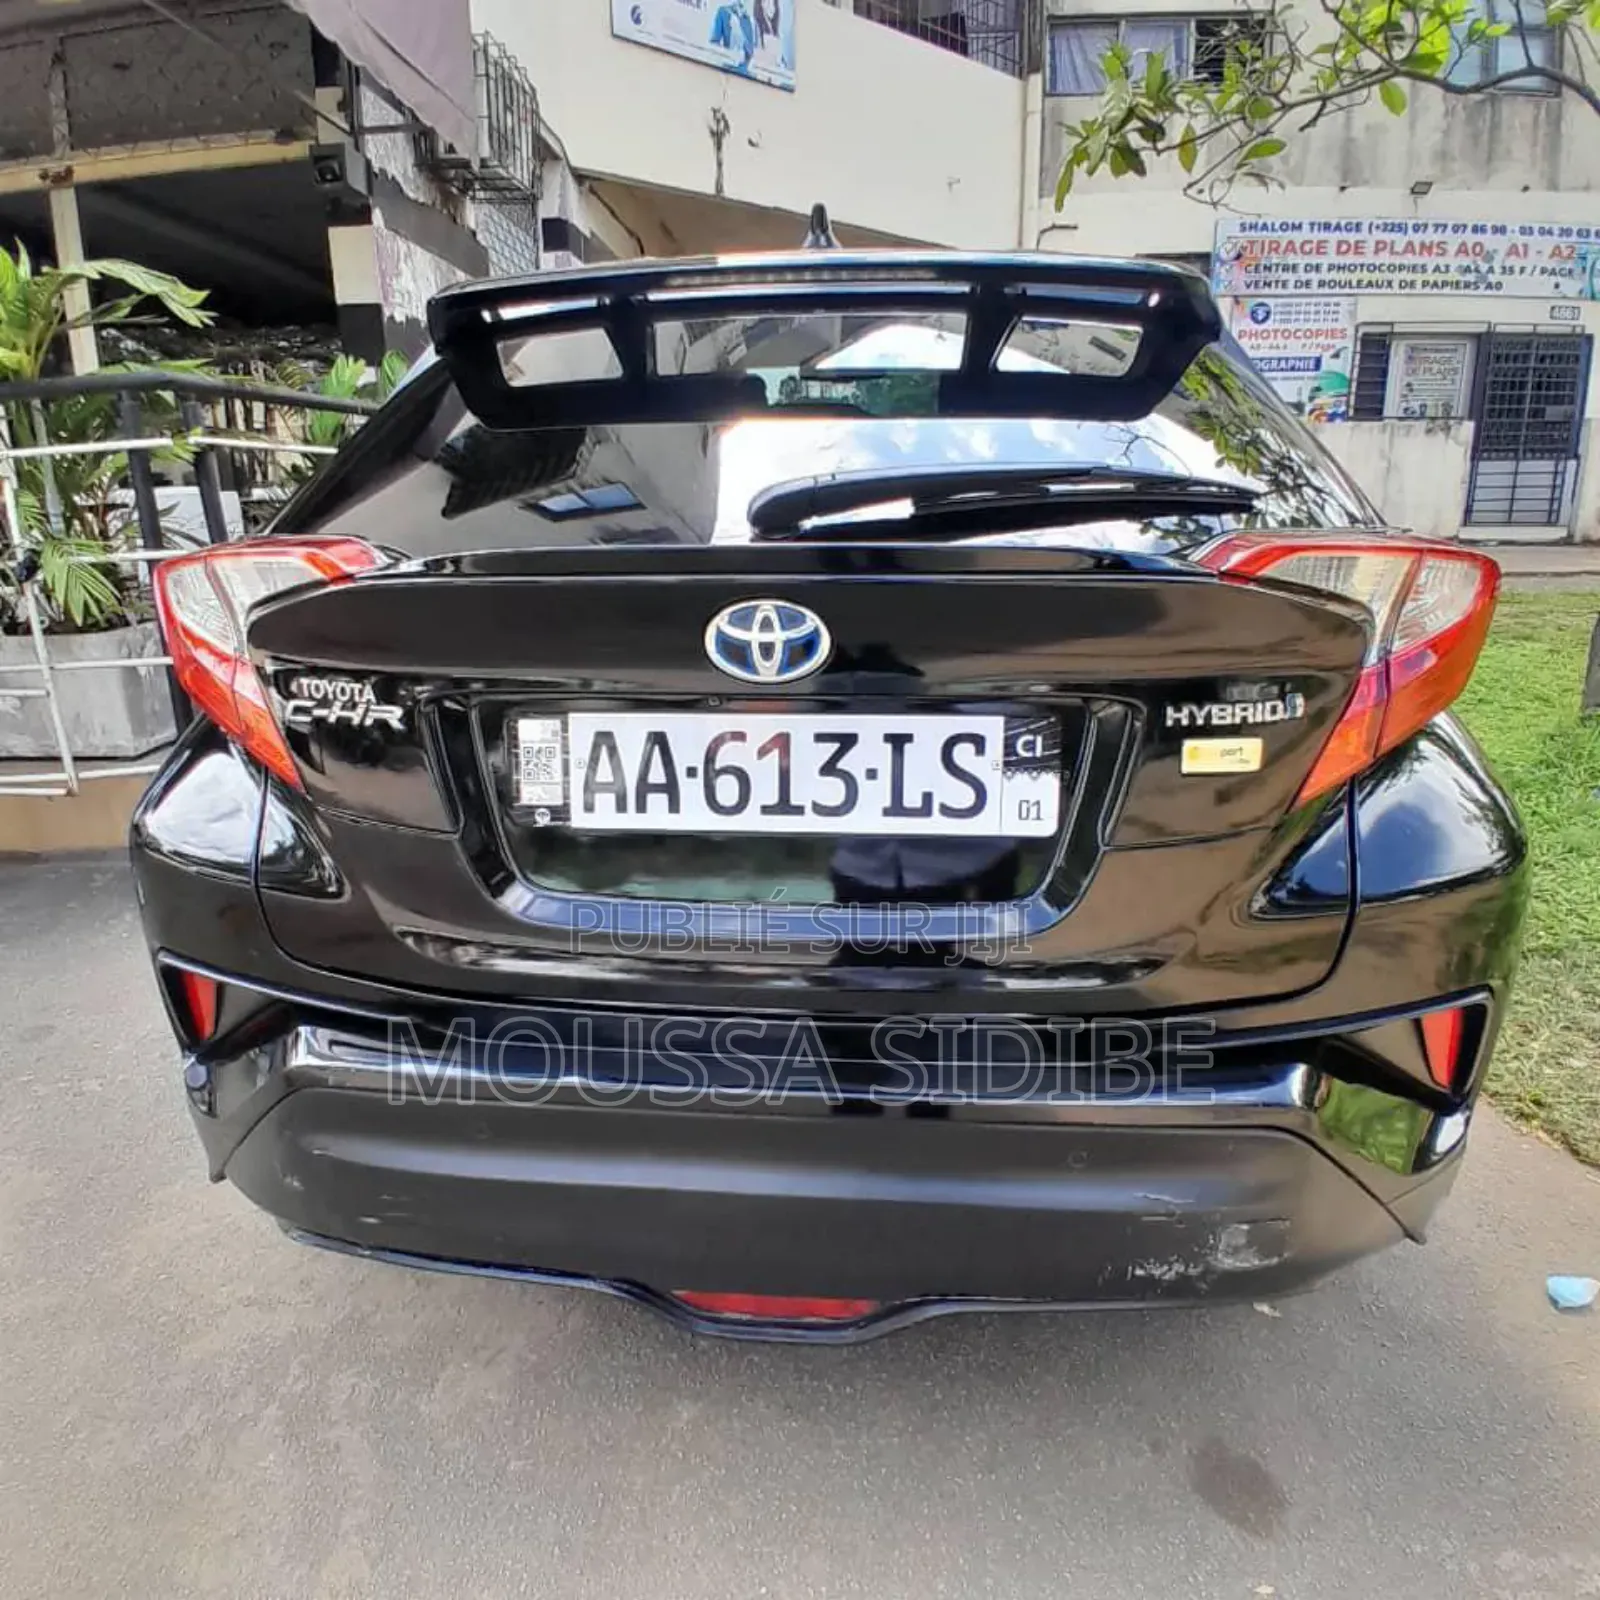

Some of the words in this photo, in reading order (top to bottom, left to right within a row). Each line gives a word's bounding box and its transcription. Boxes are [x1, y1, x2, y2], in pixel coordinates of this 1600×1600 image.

[1239, 221, 1303, 233] SHALOM
[1308, 221, 1363, 233] TIRAGE
[1367, 222, 1409, 236] (+225)
[1412, 223, 1429, 233] 07
[1245, 239, 1329, 256] TIRAGE
[1336, 240, 1367, 256] DE
[1374, 240, 1448, 257] PLANS
[1504, 242, 1529, 259] A1
[1548, 244, 1577, 260] A2
[1244, 263, 1299, 274] CENTRE
[1304, 263, 1324, 274] DE
[1327, 263, 1428, 275] PHOTOCOPIES
[1244, 279, 1291, 290] VENTE
[1294, 280, 1313, 290] DE
[1317, 279, 1394, 290] ROULEAUX
[1399, 280, 1417, 290] DE
[1421, 280, 1481, 291] PAPIERS
[1238, 327, 1348, 341] PHOTOCOPIES
[299, 677, 377, 703] TOYOTA
[284, 699, 407, 731] C-HR
[1165, 700, 1284, 728] HYBRID
[1015, 735, 1043, 758] CI
[1017, 799, 1045, 821] 01
